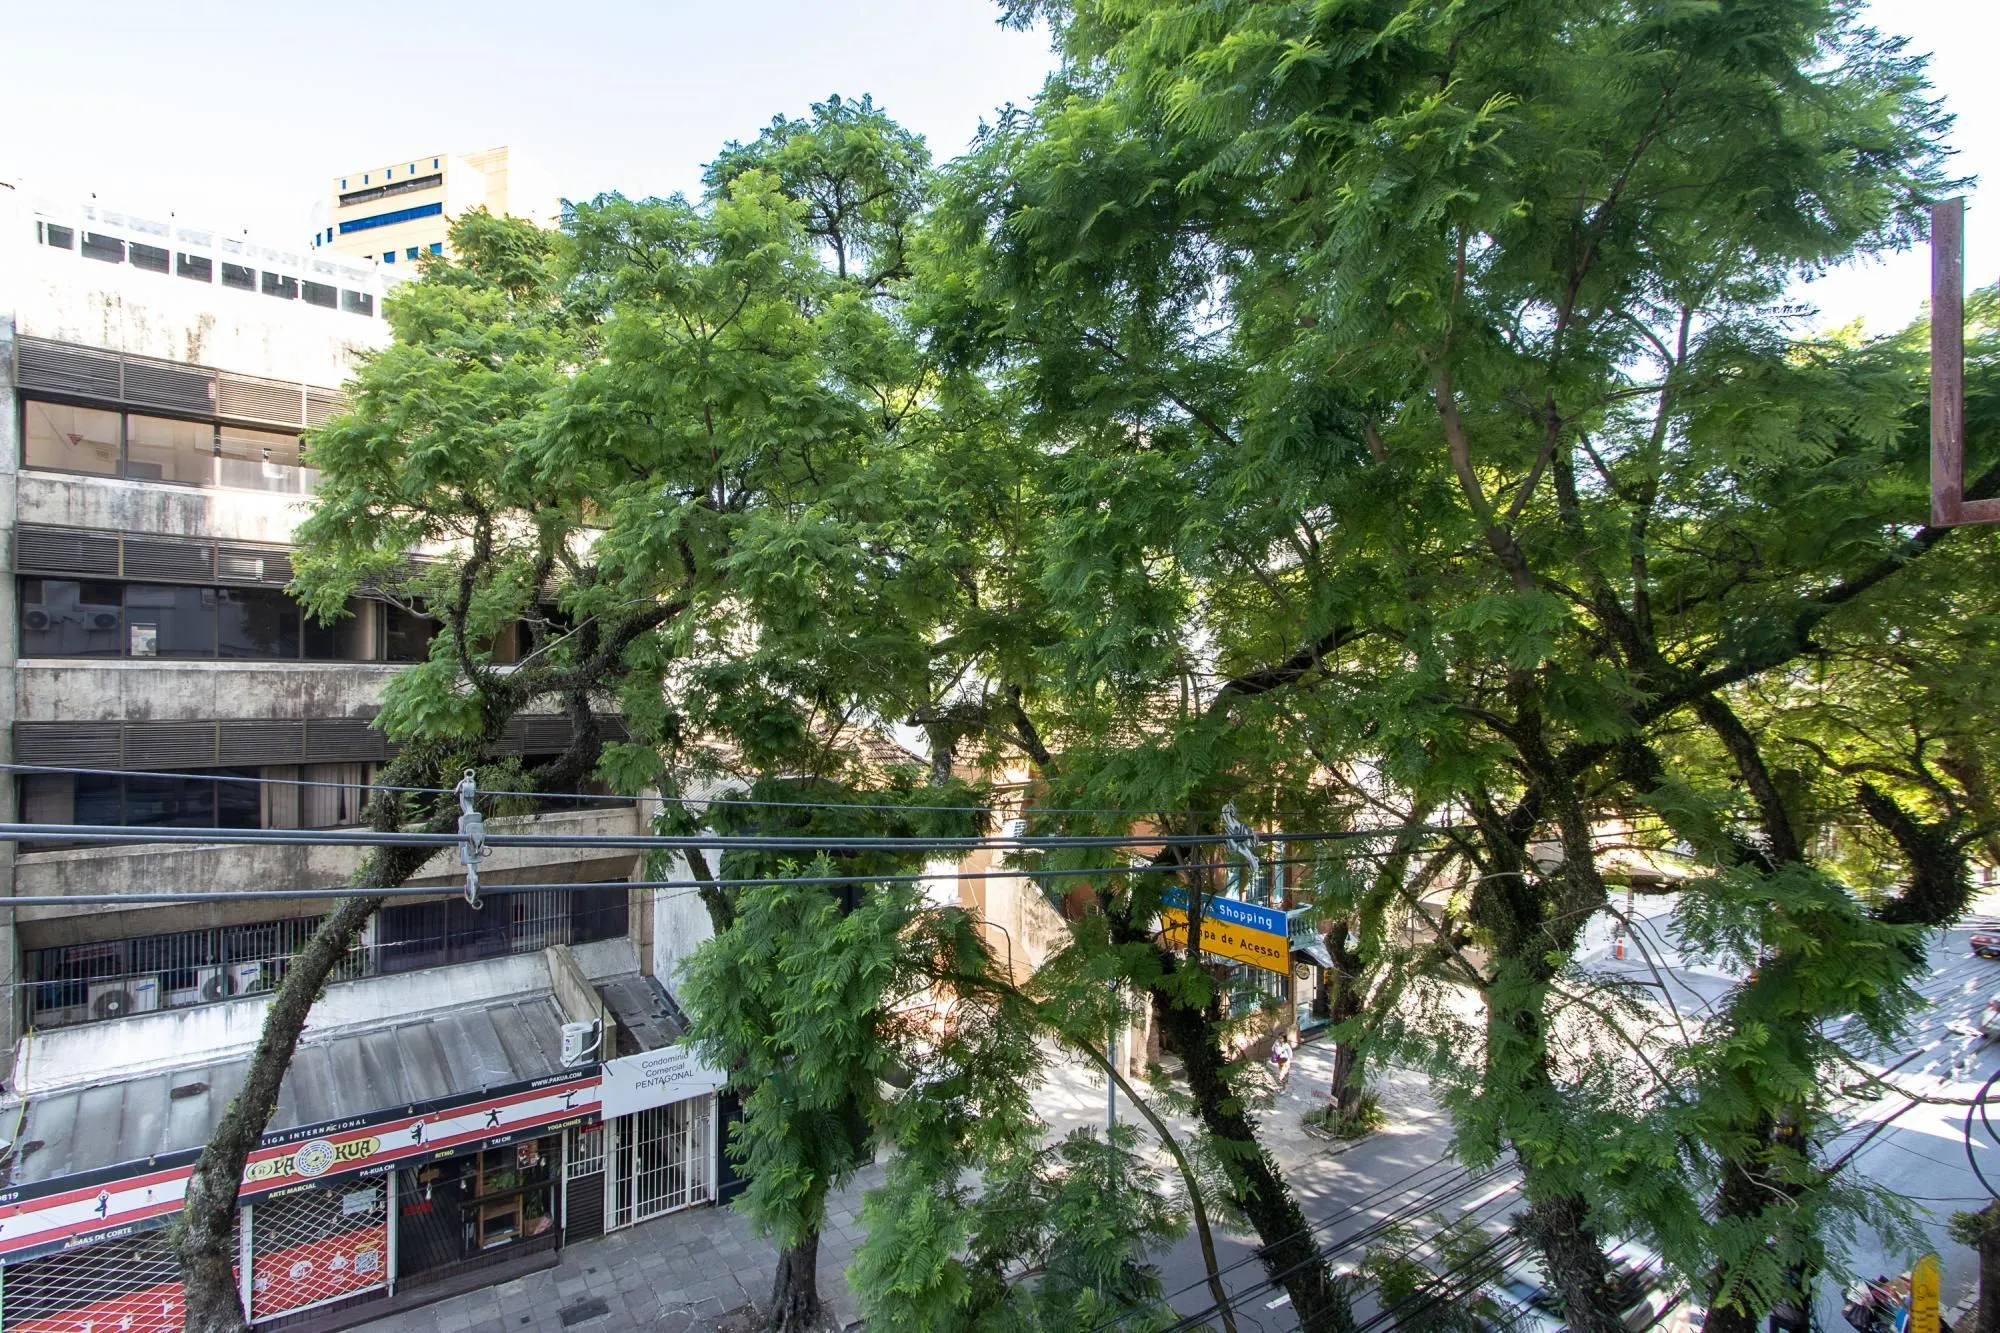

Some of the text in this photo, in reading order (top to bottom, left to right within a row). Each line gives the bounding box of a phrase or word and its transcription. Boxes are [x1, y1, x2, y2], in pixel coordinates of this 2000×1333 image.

[1219, 904, 1273, 930] Shopping
[1221, 933, 1234, 945] de
[1240, 938, 1281, 959] Acesso
[645, 1062, 685, 1077] Comercial
[531, 1071, 583, 1088] WWW.PAKUA.COM
[635, 1069, 695, 1090] PENTAGONAL
[261, 1118, 368, 1147] LIGA INTERNACIONAL
[547, 1123, 563, 1131] YOGA
[334, 1138, 372, 1160] KUA
[434, 1149, 455, 1159] RITMO
[359, 1163, 396, 1177] PA-KUA CHI
[268, 1183, 317, 1199] ARTE MARCIAL
[94, 1233, 106, 1242] DE
[106, 1226, 133, 1239] CORTE
